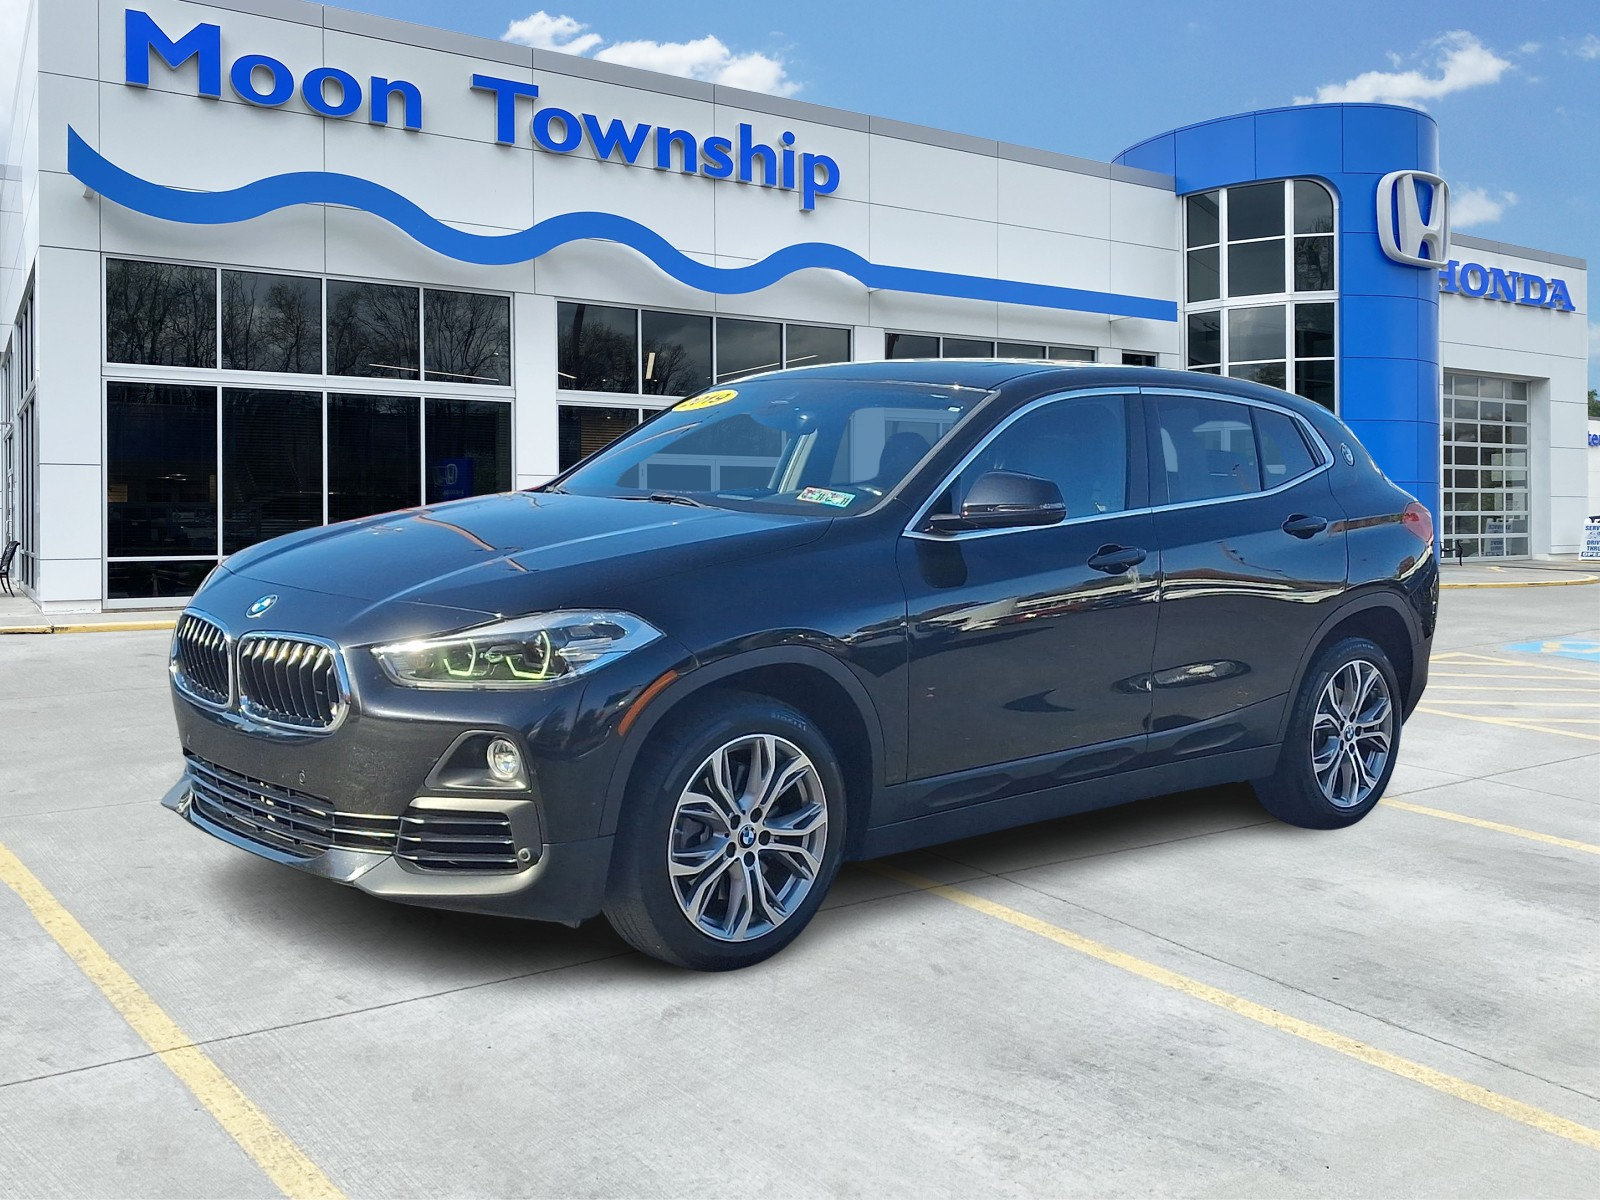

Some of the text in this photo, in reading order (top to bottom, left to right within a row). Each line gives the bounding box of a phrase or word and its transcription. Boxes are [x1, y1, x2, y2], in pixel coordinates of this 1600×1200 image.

[124, 9, 841, 212] Moon Township
[1438, 260, 1576, 312] HONDA
